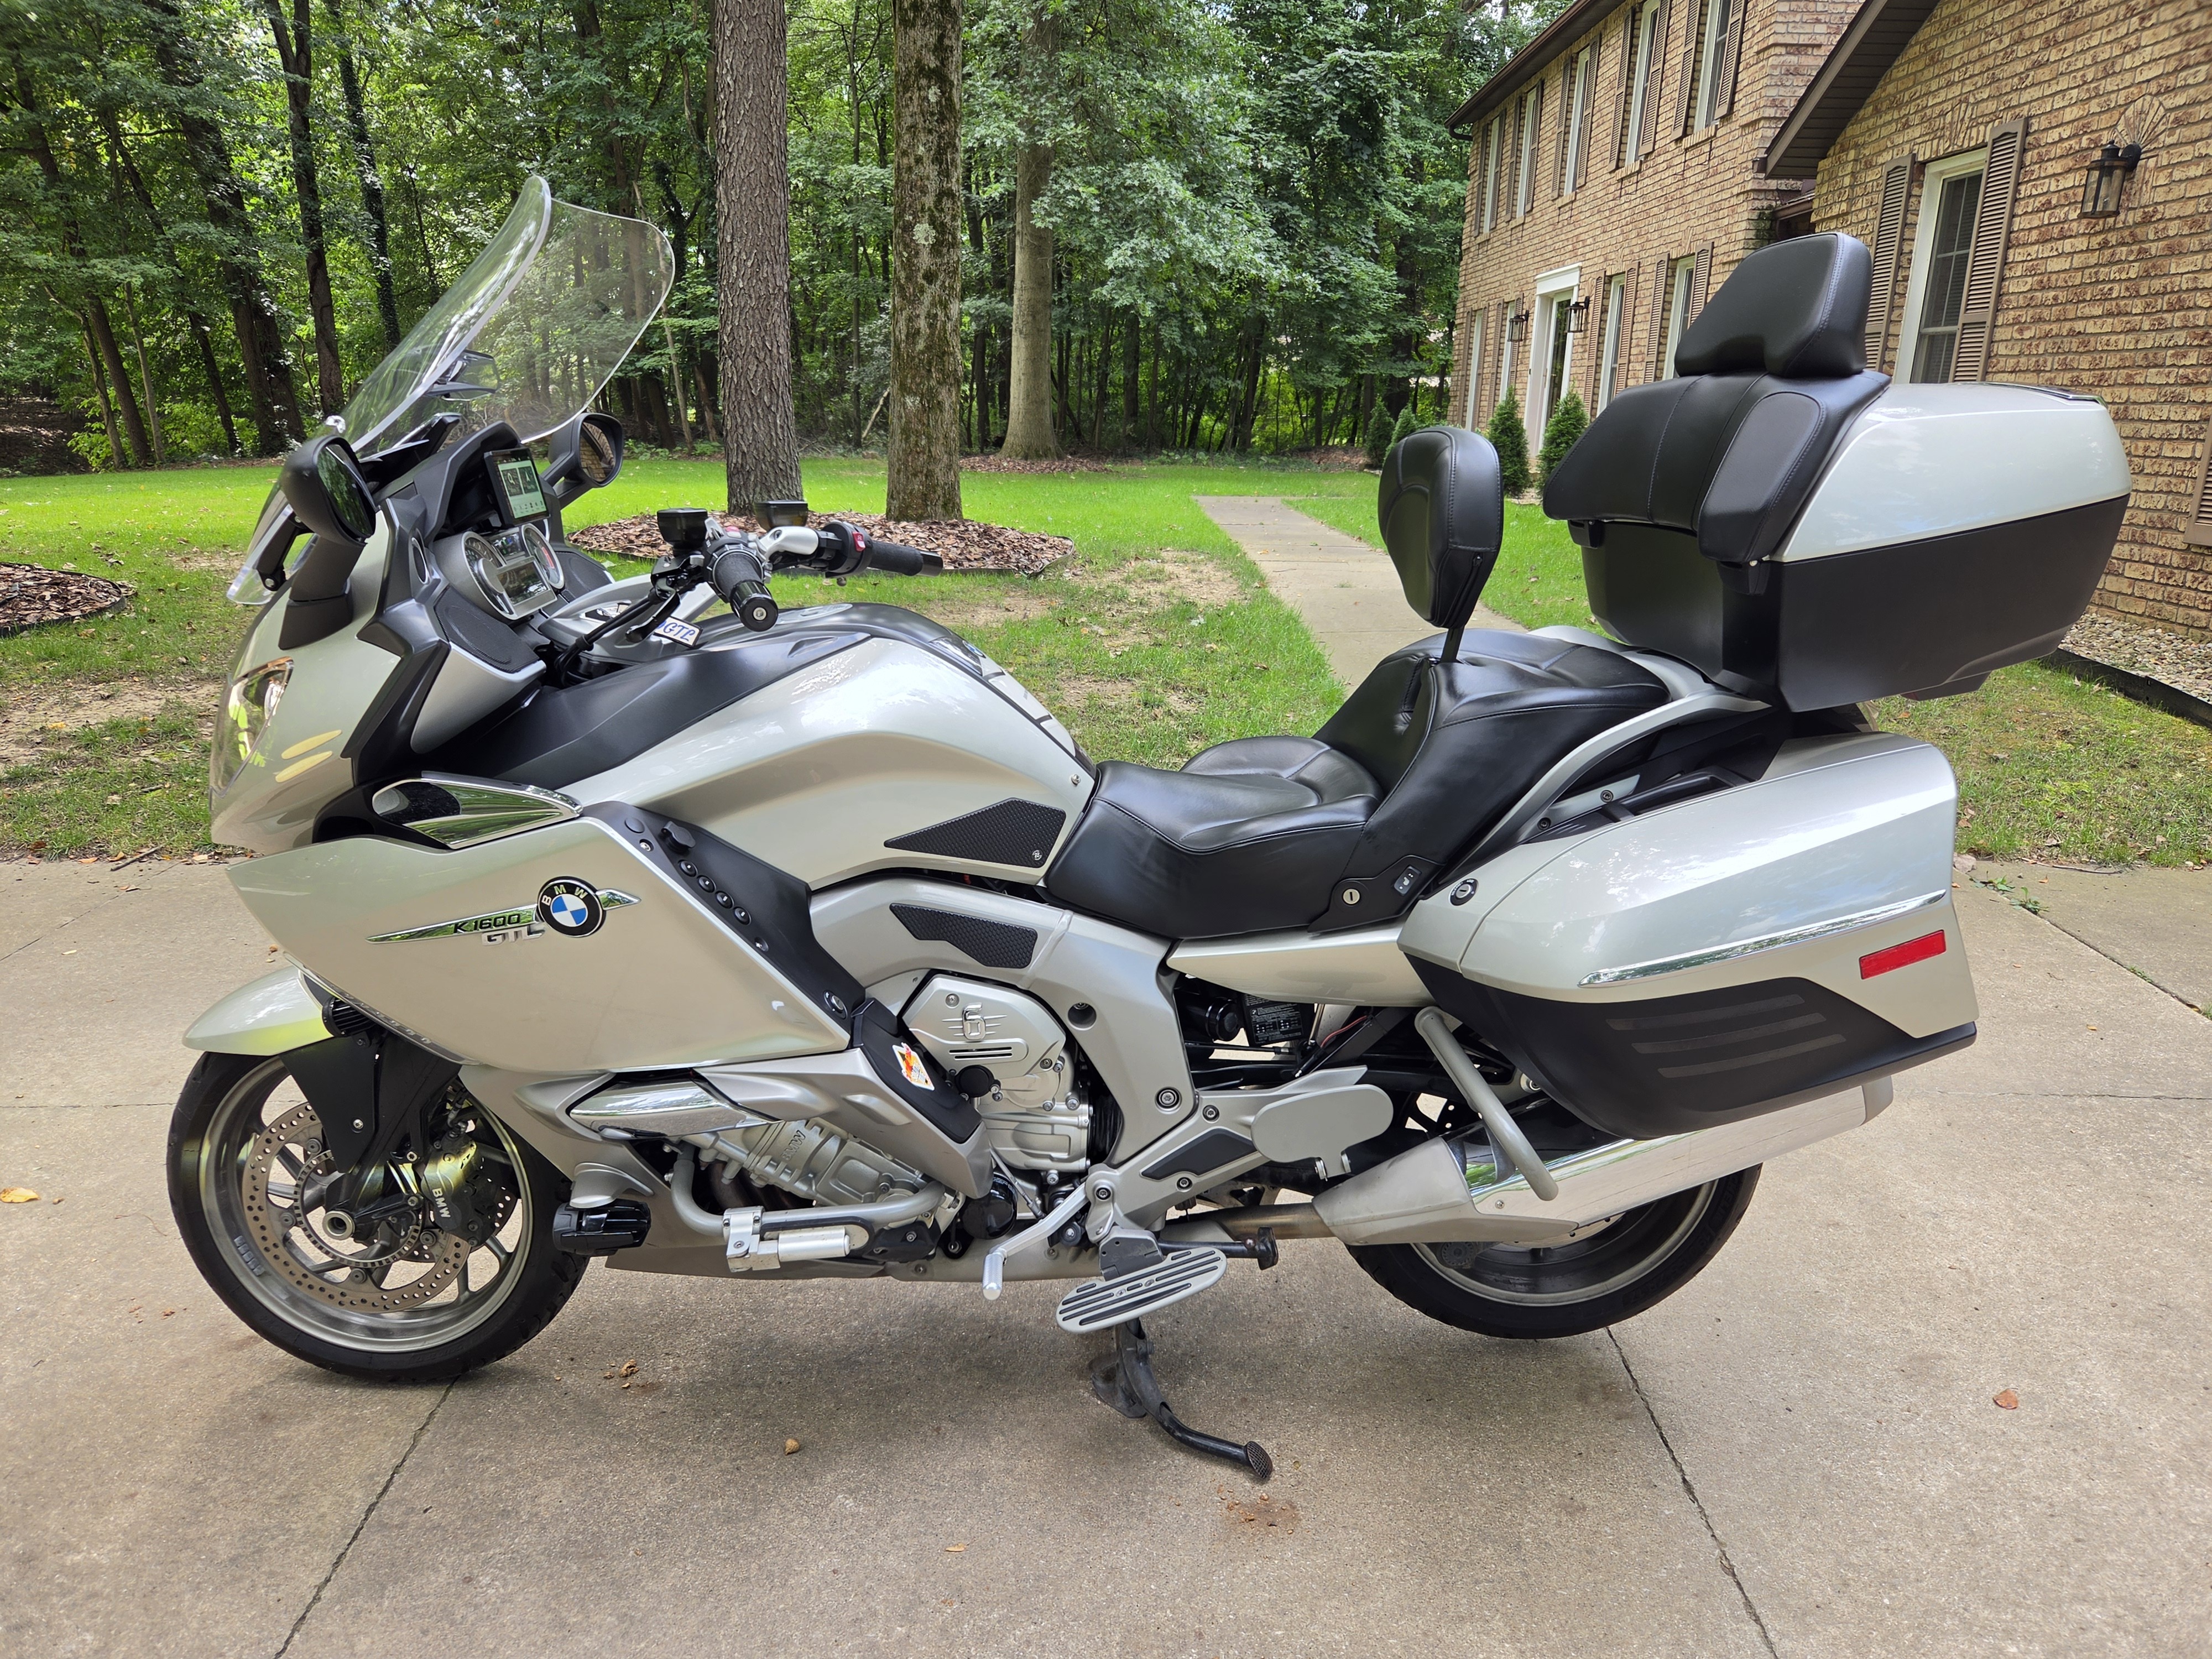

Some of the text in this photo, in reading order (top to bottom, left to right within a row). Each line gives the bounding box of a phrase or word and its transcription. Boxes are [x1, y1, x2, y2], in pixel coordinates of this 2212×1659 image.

[541, 884, 588, 906] BMW
[481, 925, 545, 947] GTL
[780, 1129, 806, 1161] BMW
[431, 1187, 451, 1218] BMW
